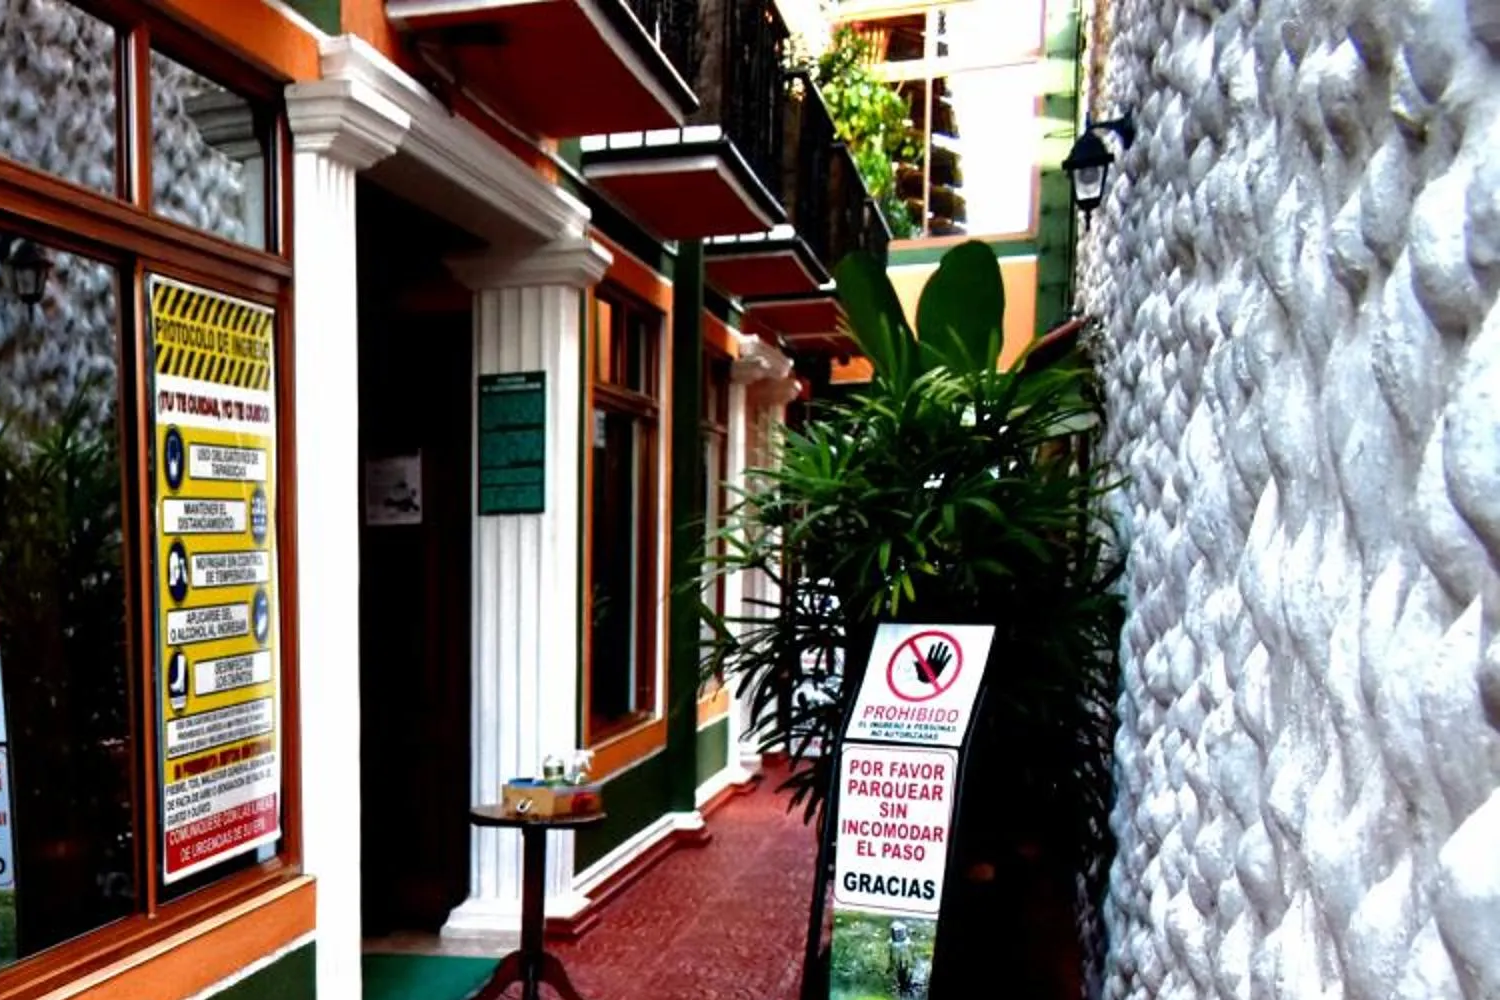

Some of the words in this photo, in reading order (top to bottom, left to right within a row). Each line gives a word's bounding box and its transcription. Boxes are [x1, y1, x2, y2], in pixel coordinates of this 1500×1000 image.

[863, 705, 959, 723] PROHIBIDO
[850, 759, 883, 777] POR
[889, 762, 944, 780] FAVOR
[847, 780, 943, 801] PARQUEAR
[879, 802, 908, 819] SIN
[842, 819, 944, 842] INCOMODAR
[857, 840, 876, 857] EL
[882, 842, 925, 861] PASO
[843, 872, 935, 900] GRACIAS
